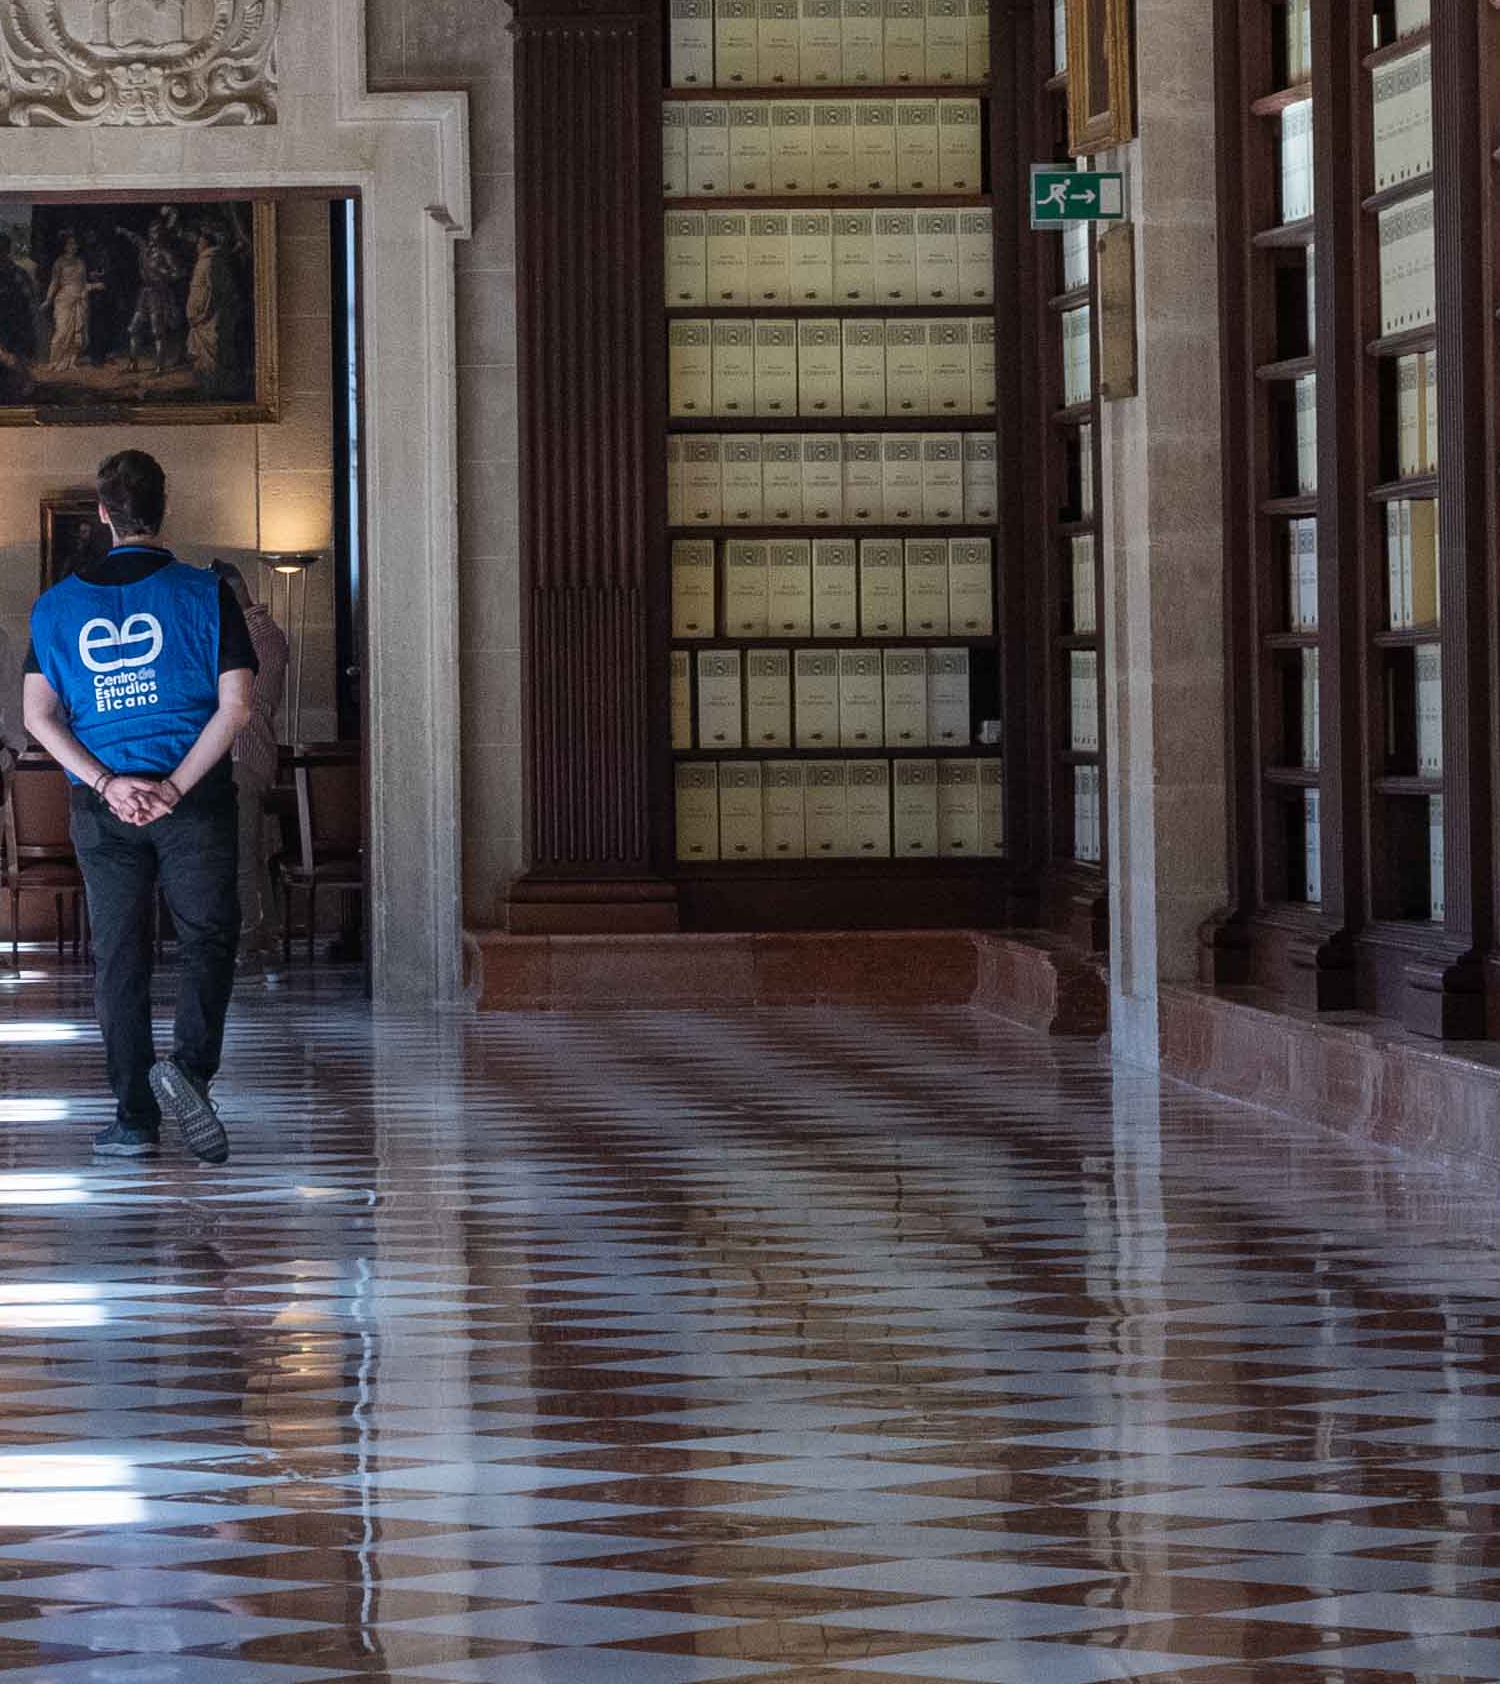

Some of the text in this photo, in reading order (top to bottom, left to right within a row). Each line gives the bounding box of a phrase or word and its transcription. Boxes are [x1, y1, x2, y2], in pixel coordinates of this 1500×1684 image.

[93, 672, 137, 687] Centro
[95, 681, 157, 701] Estudios
[96, 693, 158, 713] Elcano
